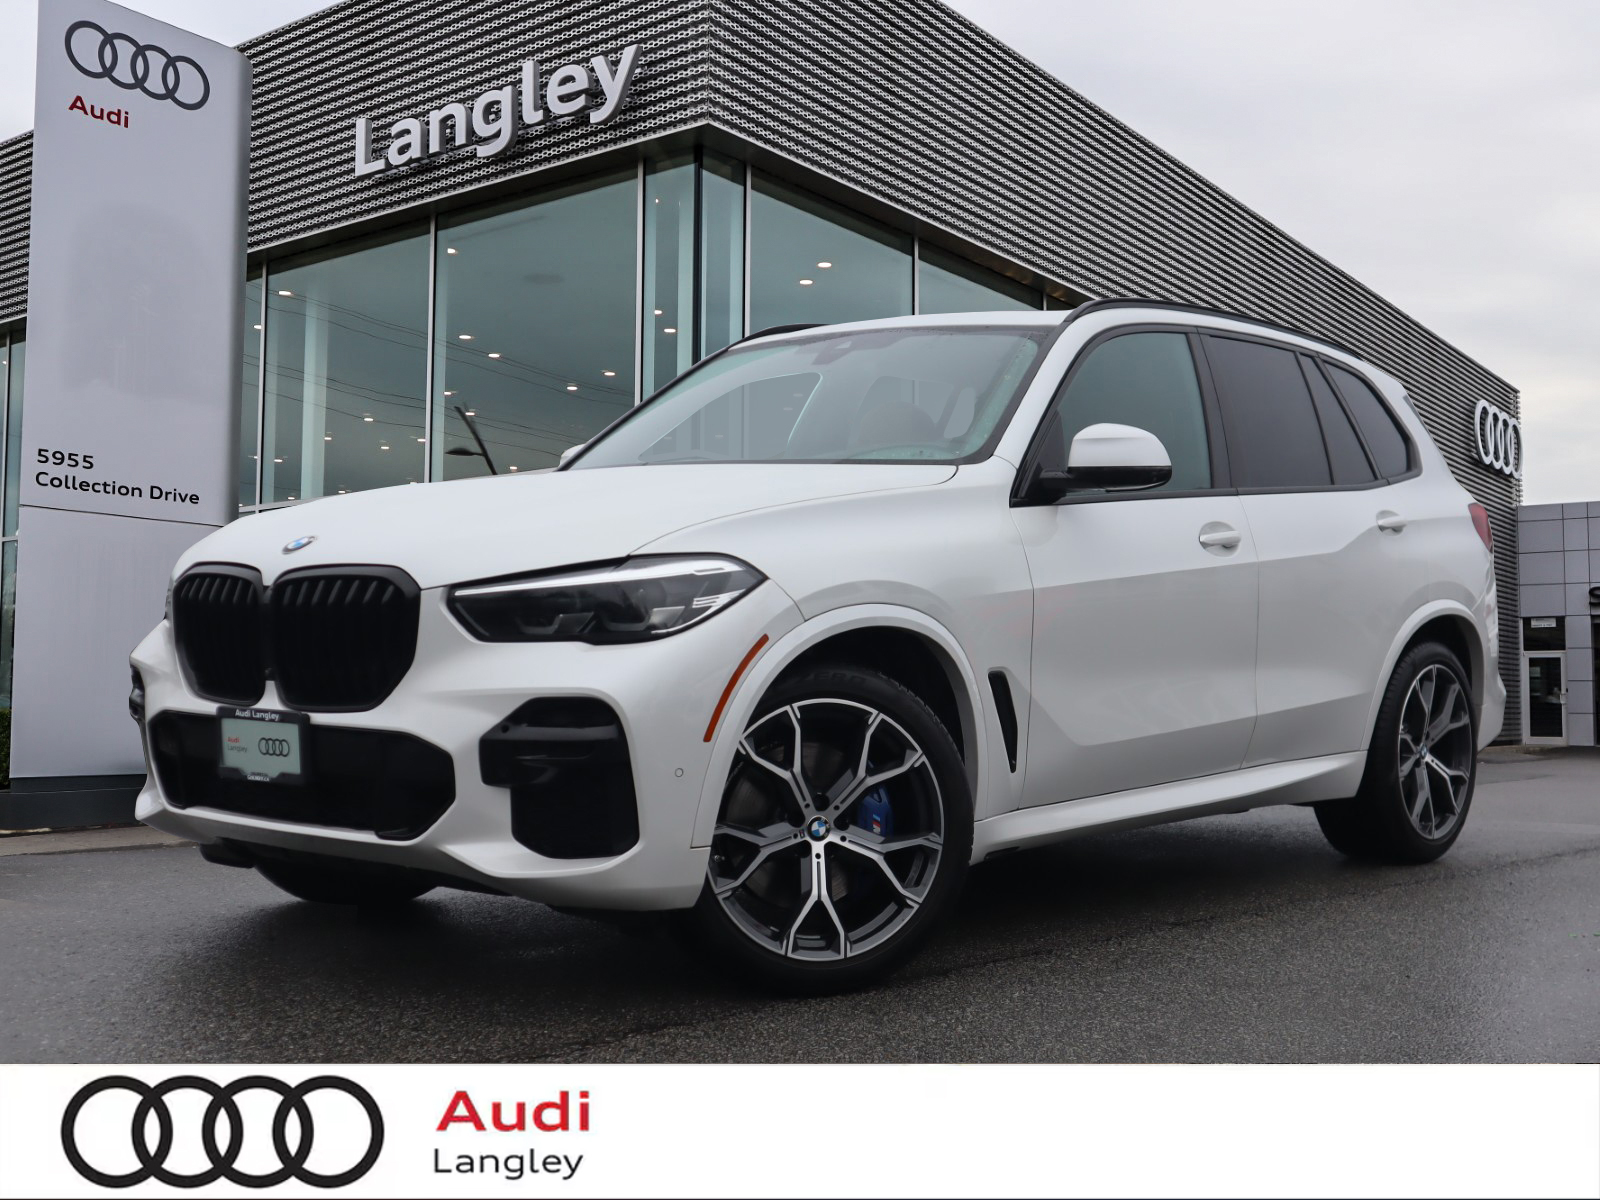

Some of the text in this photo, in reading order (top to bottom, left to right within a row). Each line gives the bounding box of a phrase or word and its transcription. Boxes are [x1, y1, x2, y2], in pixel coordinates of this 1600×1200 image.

[68, 94, 129, 129] Audi
[354, 43, 643, 177] Langley
[36, 448, 94, 470] 5955
[35, 471, 200, 504] Collection Drive
[235, 708, 280, 722] Audi Langley
